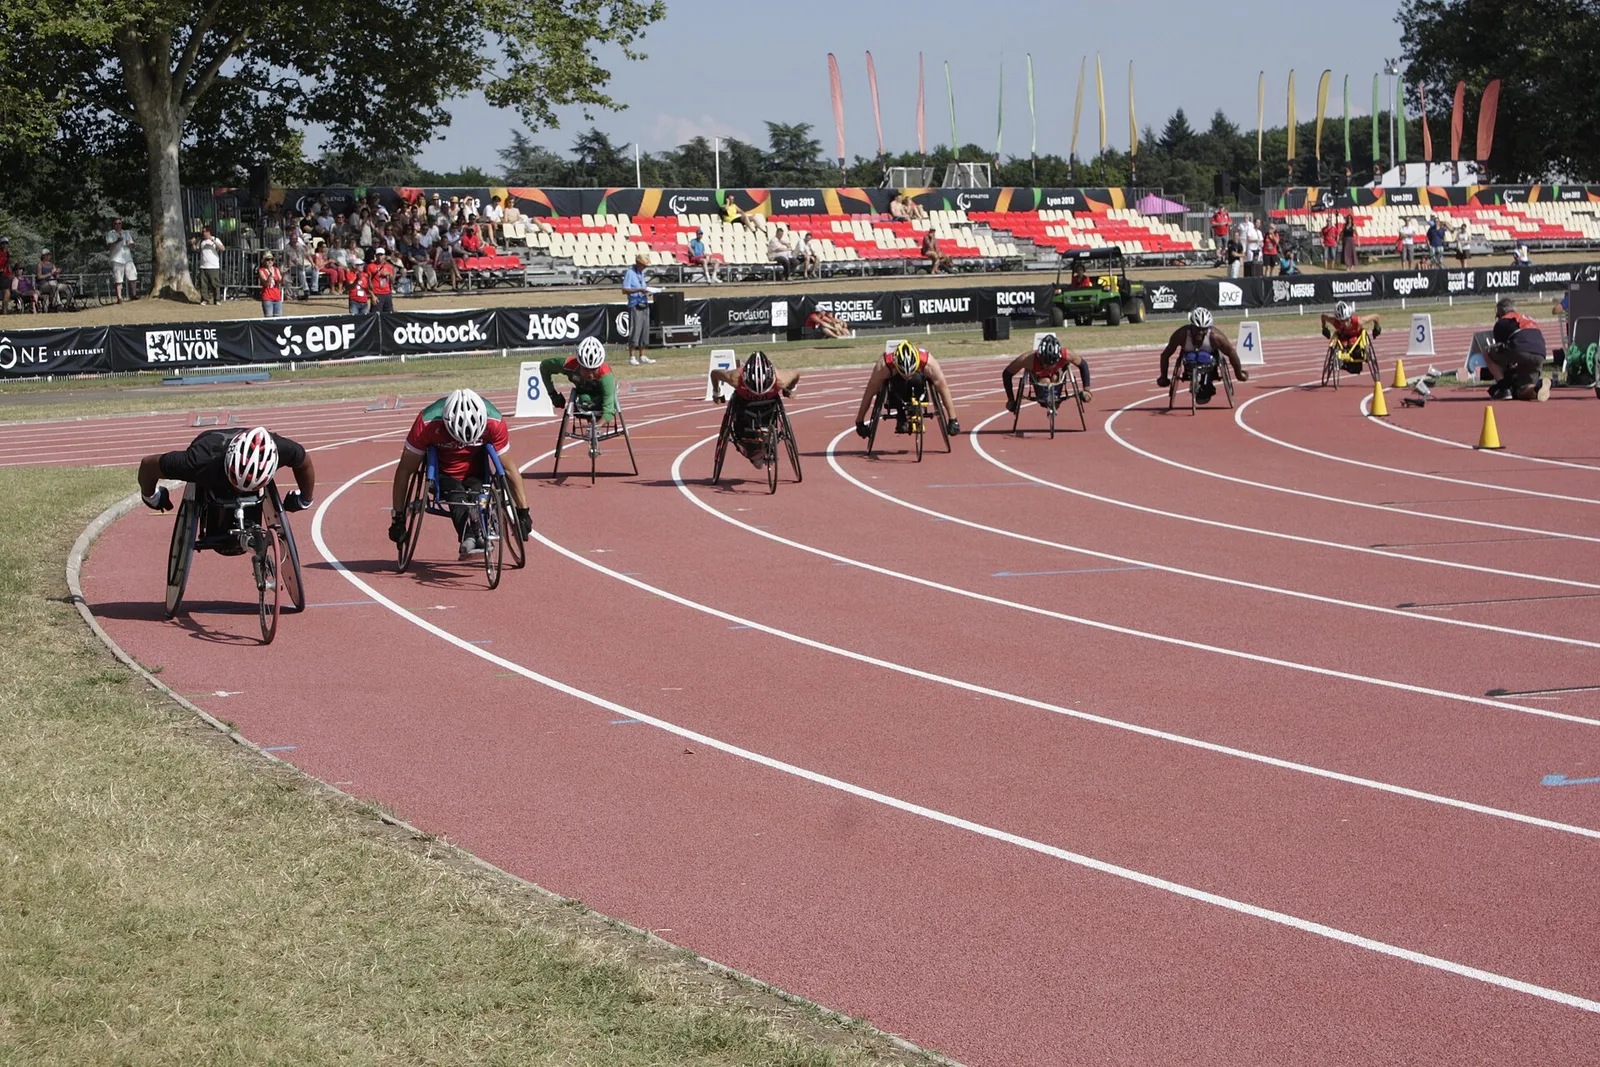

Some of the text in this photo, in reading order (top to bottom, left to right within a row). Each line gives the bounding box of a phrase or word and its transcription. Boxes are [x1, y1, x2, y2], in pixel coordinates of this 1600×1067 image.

[781, 197, 815, 209] Lyon 2013
[1047, 196, 1075, 207] Lyon 2013
[1391, 193, 1413, 203] Lyon 2013
[1393, 272, 1429, 294] aggreko
[1447, 280, 1466, 292] sport
[1486, 270, 1520, 288] DOUBLET
[996, 291, 1035, 305] RICOH
[1221, 291, 1240, 303] SNCF
[834, 299, 874, 312] SOCIETE
[918, 297, 971, 314] RENAULT
[728, 309, 770, 321] Fondation
[834, 309, 883, 322] GENERALE
[174, 328, 217, 342] VILLE DE
[393, 319, 488, 345] ottobock.
[1415, 324, 1426, 343] 3
[1243, 332, 1254, 352] 4
[176, 341, 219, 361] LYON
[527, 376, 540, 401] 8
